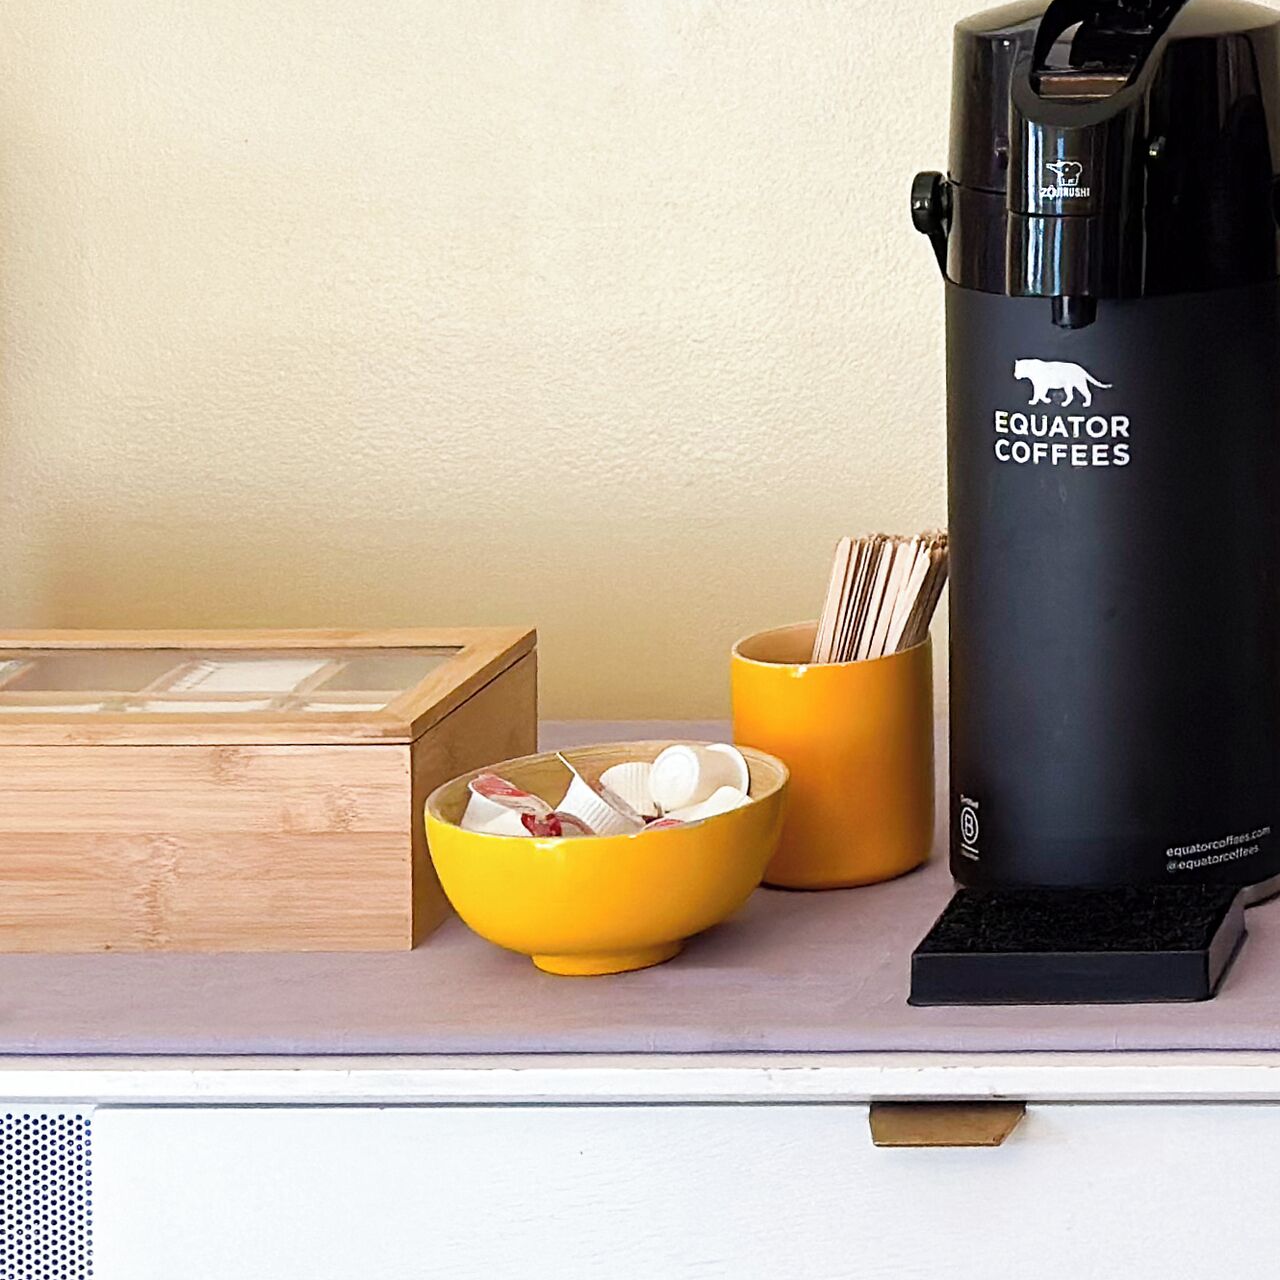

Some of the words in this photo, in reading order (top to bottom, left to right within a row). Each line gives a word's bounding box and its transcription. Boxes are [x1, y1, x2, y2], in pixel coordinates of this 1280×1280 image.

[994, 410, 1131, 439] EQUATOR
[994, 439, 1131, 467] COFFEES
[1165, 825, 1271, 858] equatorcoffees.com
[1166, 844, 1260, 873] @equatorcoffees
